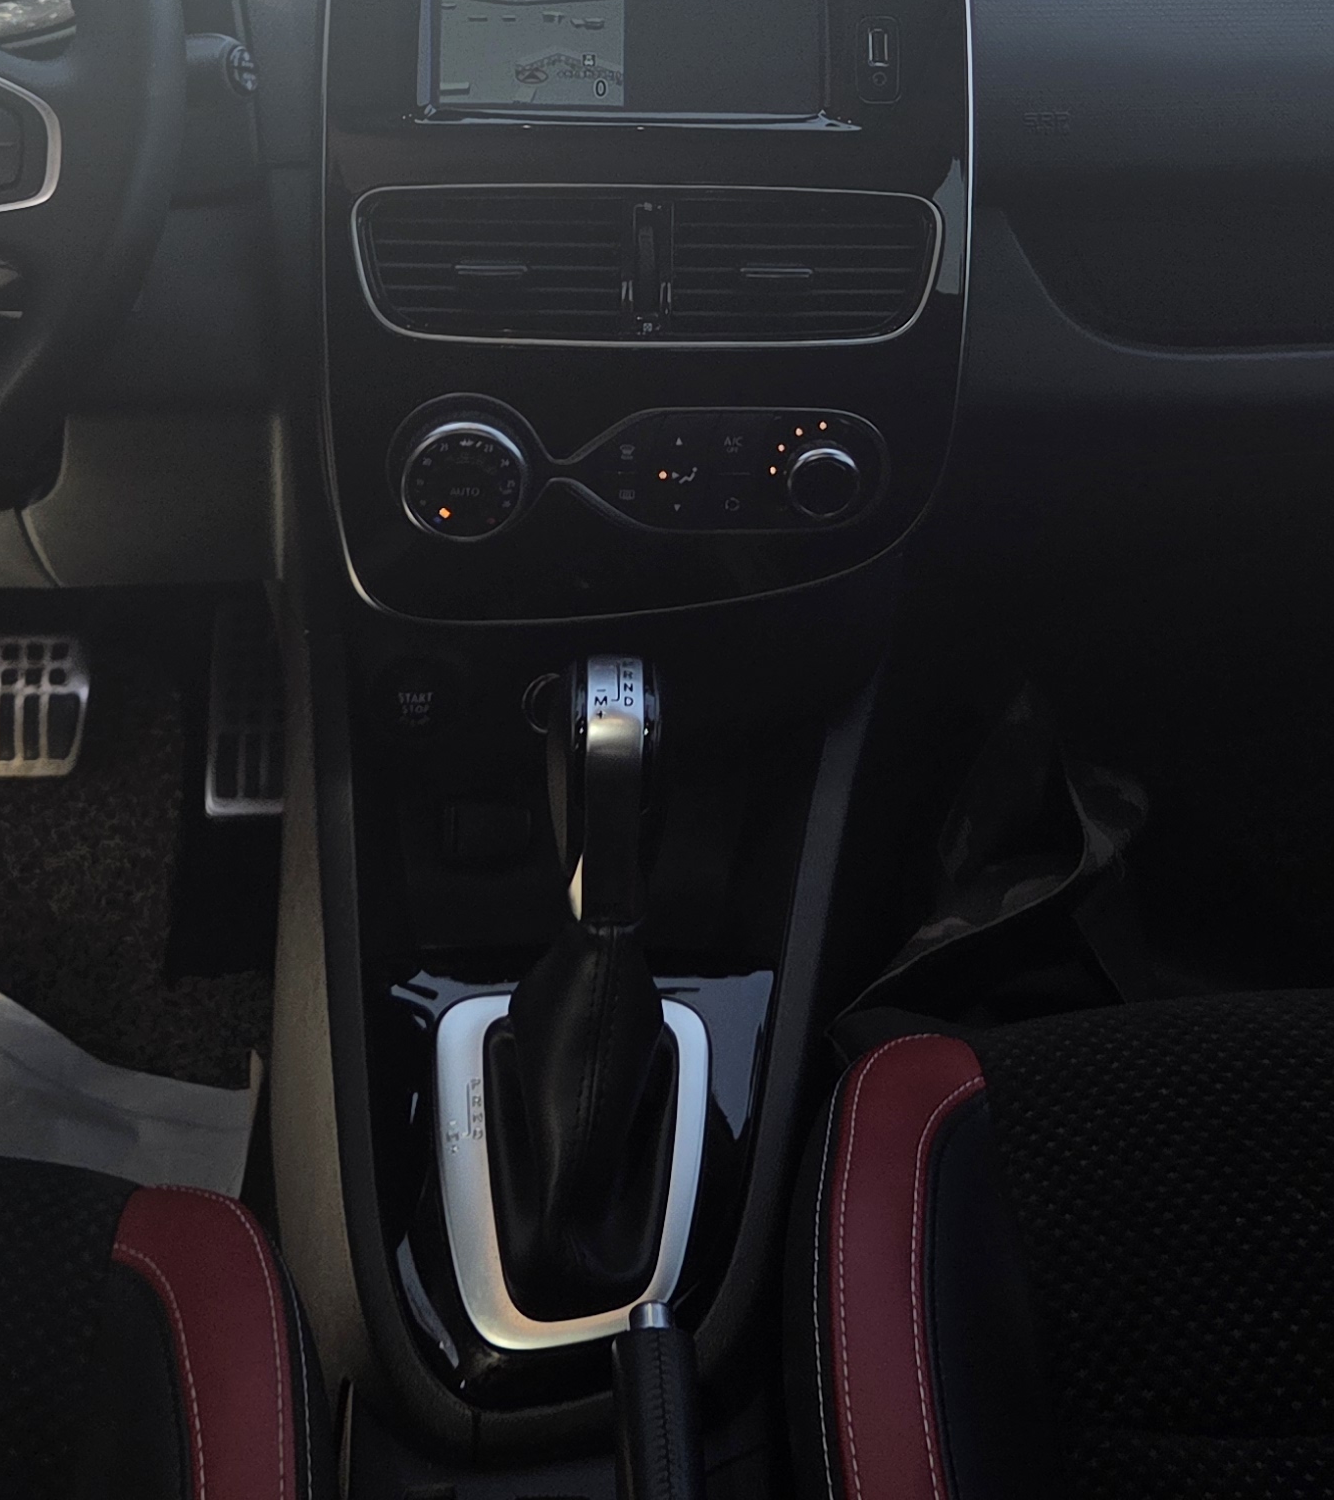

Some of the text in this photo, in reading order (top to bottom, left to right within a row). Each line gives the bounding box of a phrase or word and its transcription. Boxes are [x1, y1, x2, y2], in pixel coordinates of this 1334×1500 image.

[723, 435, 744, 447] A/C
[449, 486, 481, 497] AUTO
[623, 682, 634, 693] N
[398, 691, 434, 704] START
[594, 695, 608, 707] M
[623, 695, 634, 707] D
